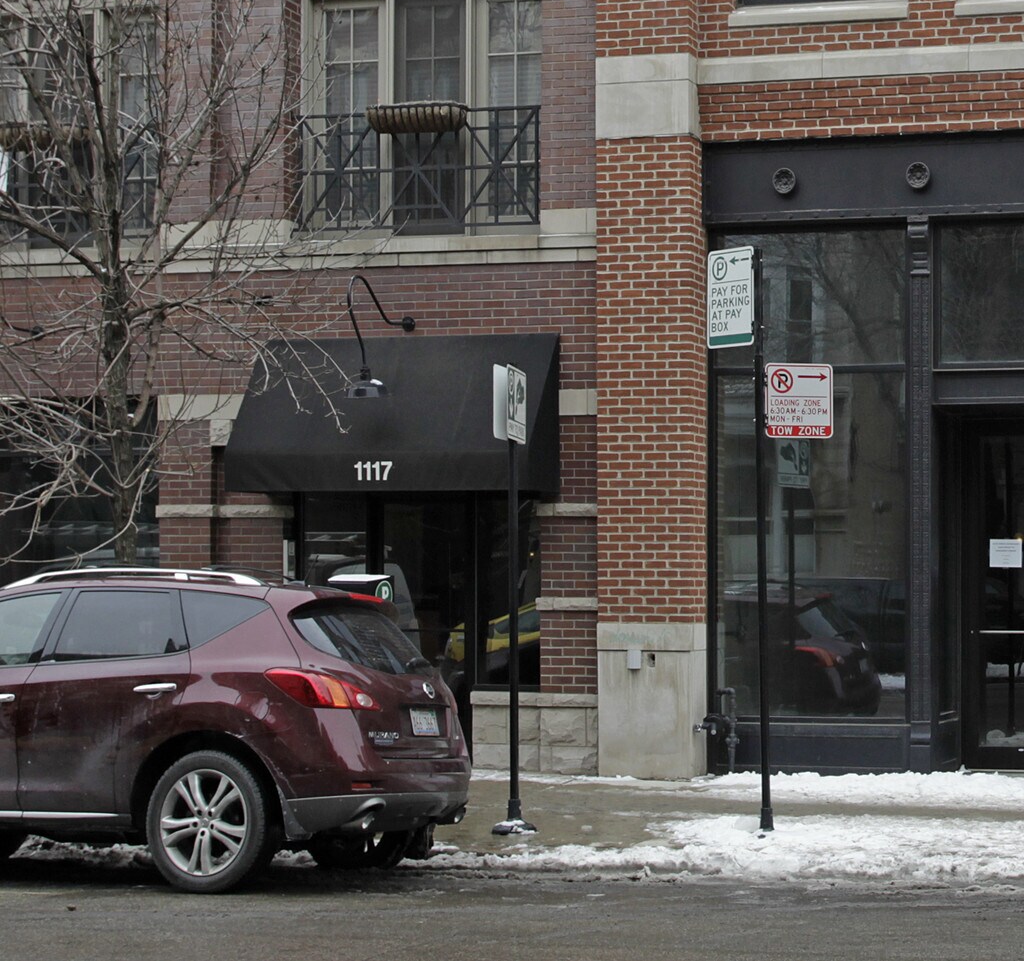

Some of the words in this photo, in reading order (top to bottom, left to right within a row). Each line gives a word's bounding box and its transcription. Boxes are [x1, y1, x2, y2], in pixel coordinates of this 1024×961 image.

[711, 286, 728, 298] PAY
[730, 284, 748, 296] FOR
[711, 295, 750, 310] PARKING
[711, 309, 723, 321] AT
[725, 308, 742, 319] PAY
[711, 321, 729, 333] BOX
[770, 399, 800, 407] LOADING
[803, 399, 822, 407] ZONE
[770, 415, 786, 423] MON
[791, 415, 804, 423] FRI
[771, 426, 793, 436] TOW
[798, 426, 827, 436] ZONE
[353, 460, 393, 481] 1117
